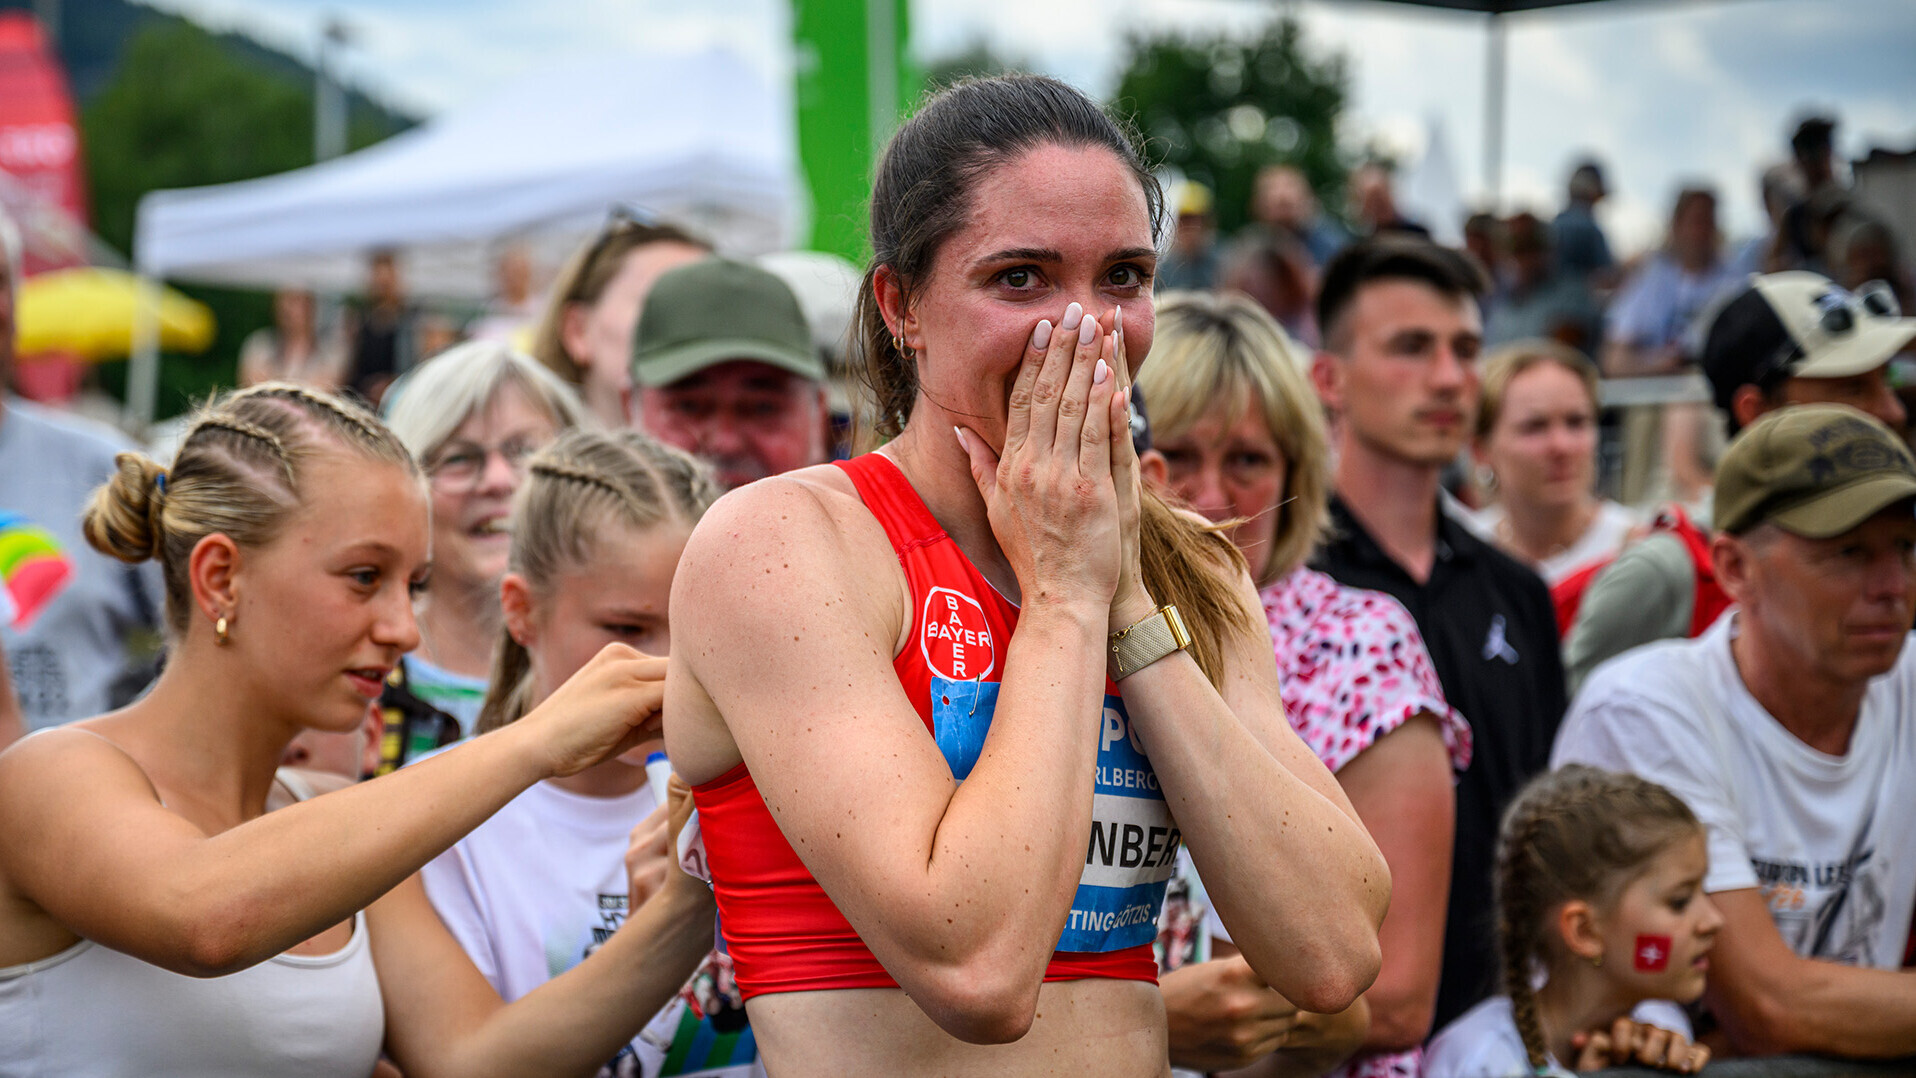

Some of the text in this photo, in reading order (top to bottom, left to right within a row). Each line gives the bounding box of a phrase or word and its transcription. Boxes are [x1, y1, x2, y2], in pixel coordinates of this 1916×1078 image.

[927, 621, 992, 647] BAYER
[945, 595, 967, 677] BAYER
[1086, 820, 1181, 868] NBER
[1064, 909, 1115, 932] TING
